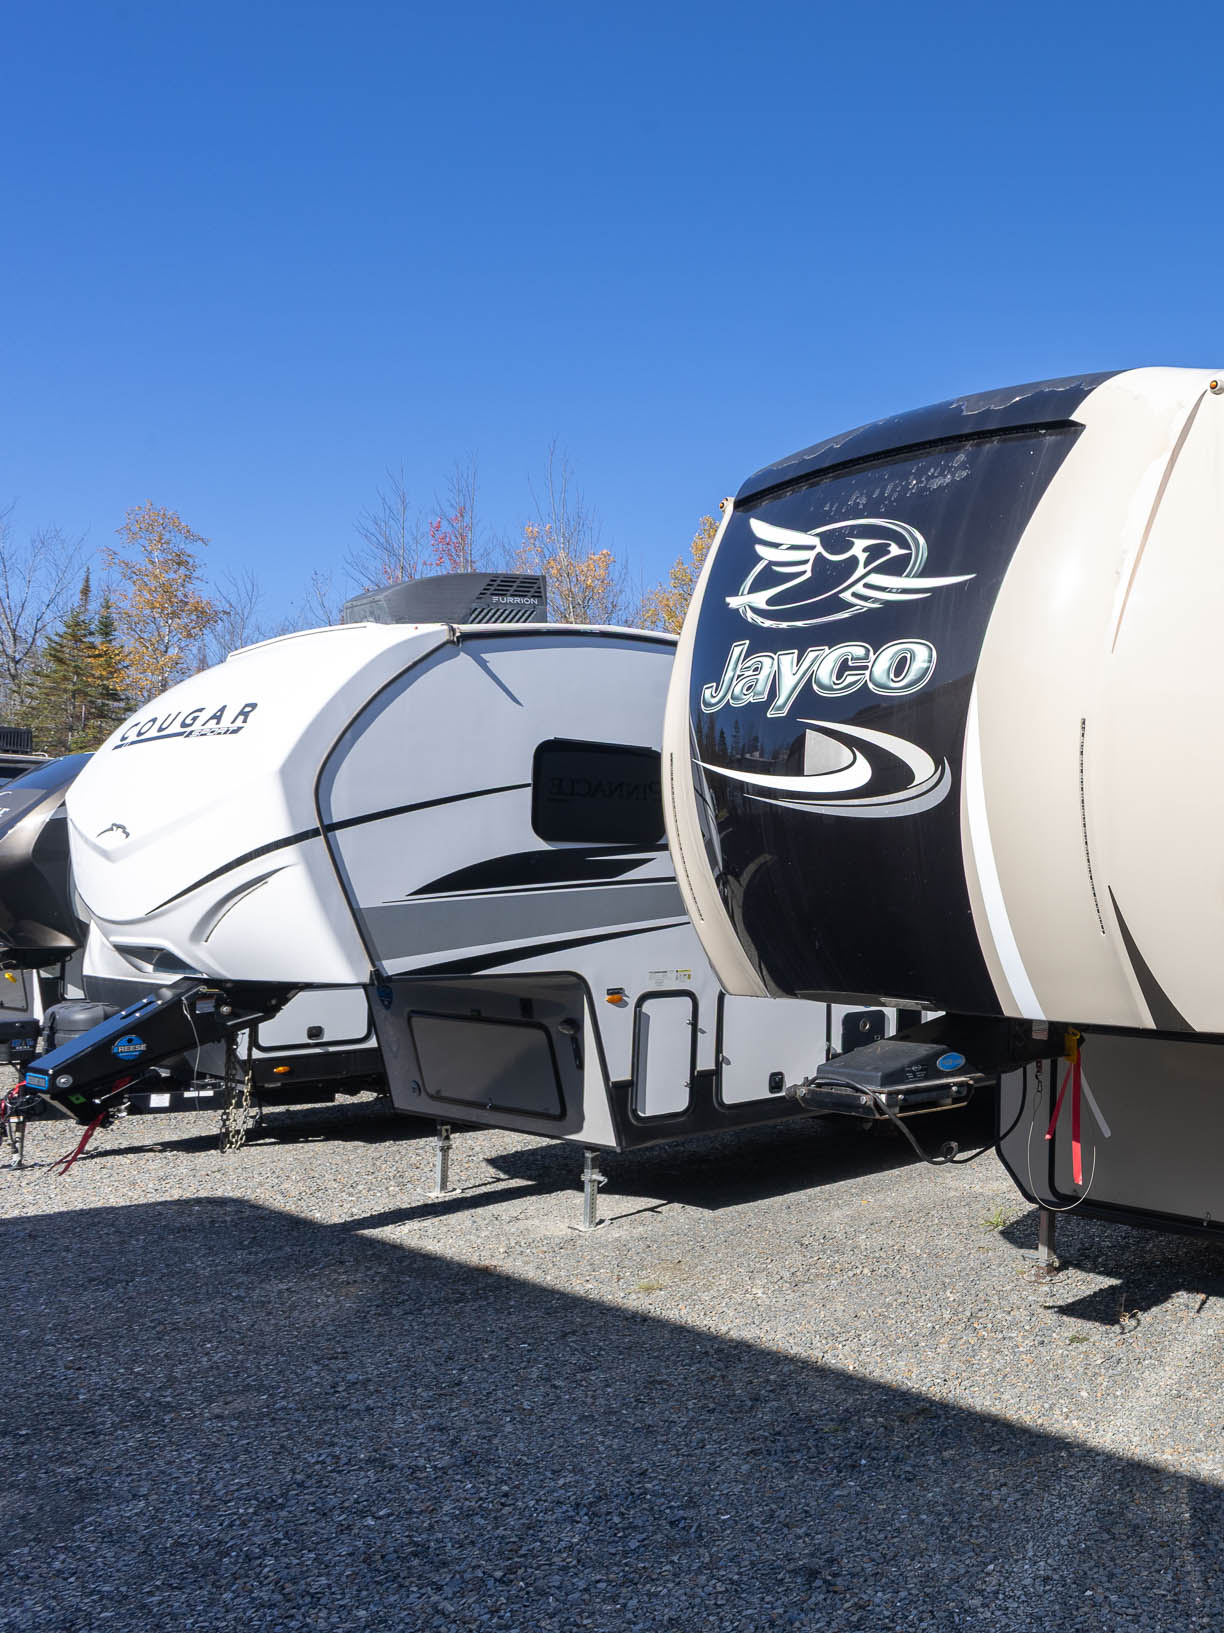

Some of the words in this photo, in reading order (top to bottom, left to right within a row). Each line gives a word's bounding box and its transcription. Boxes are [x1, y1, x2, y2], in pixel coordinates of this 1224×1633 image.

[492, 596, 538, 605] FURRION
[701, 639, 938, 718] Jayco
[119, 702, 258, 742] COUGAR
[190, 727, 238, 738] SPORT
